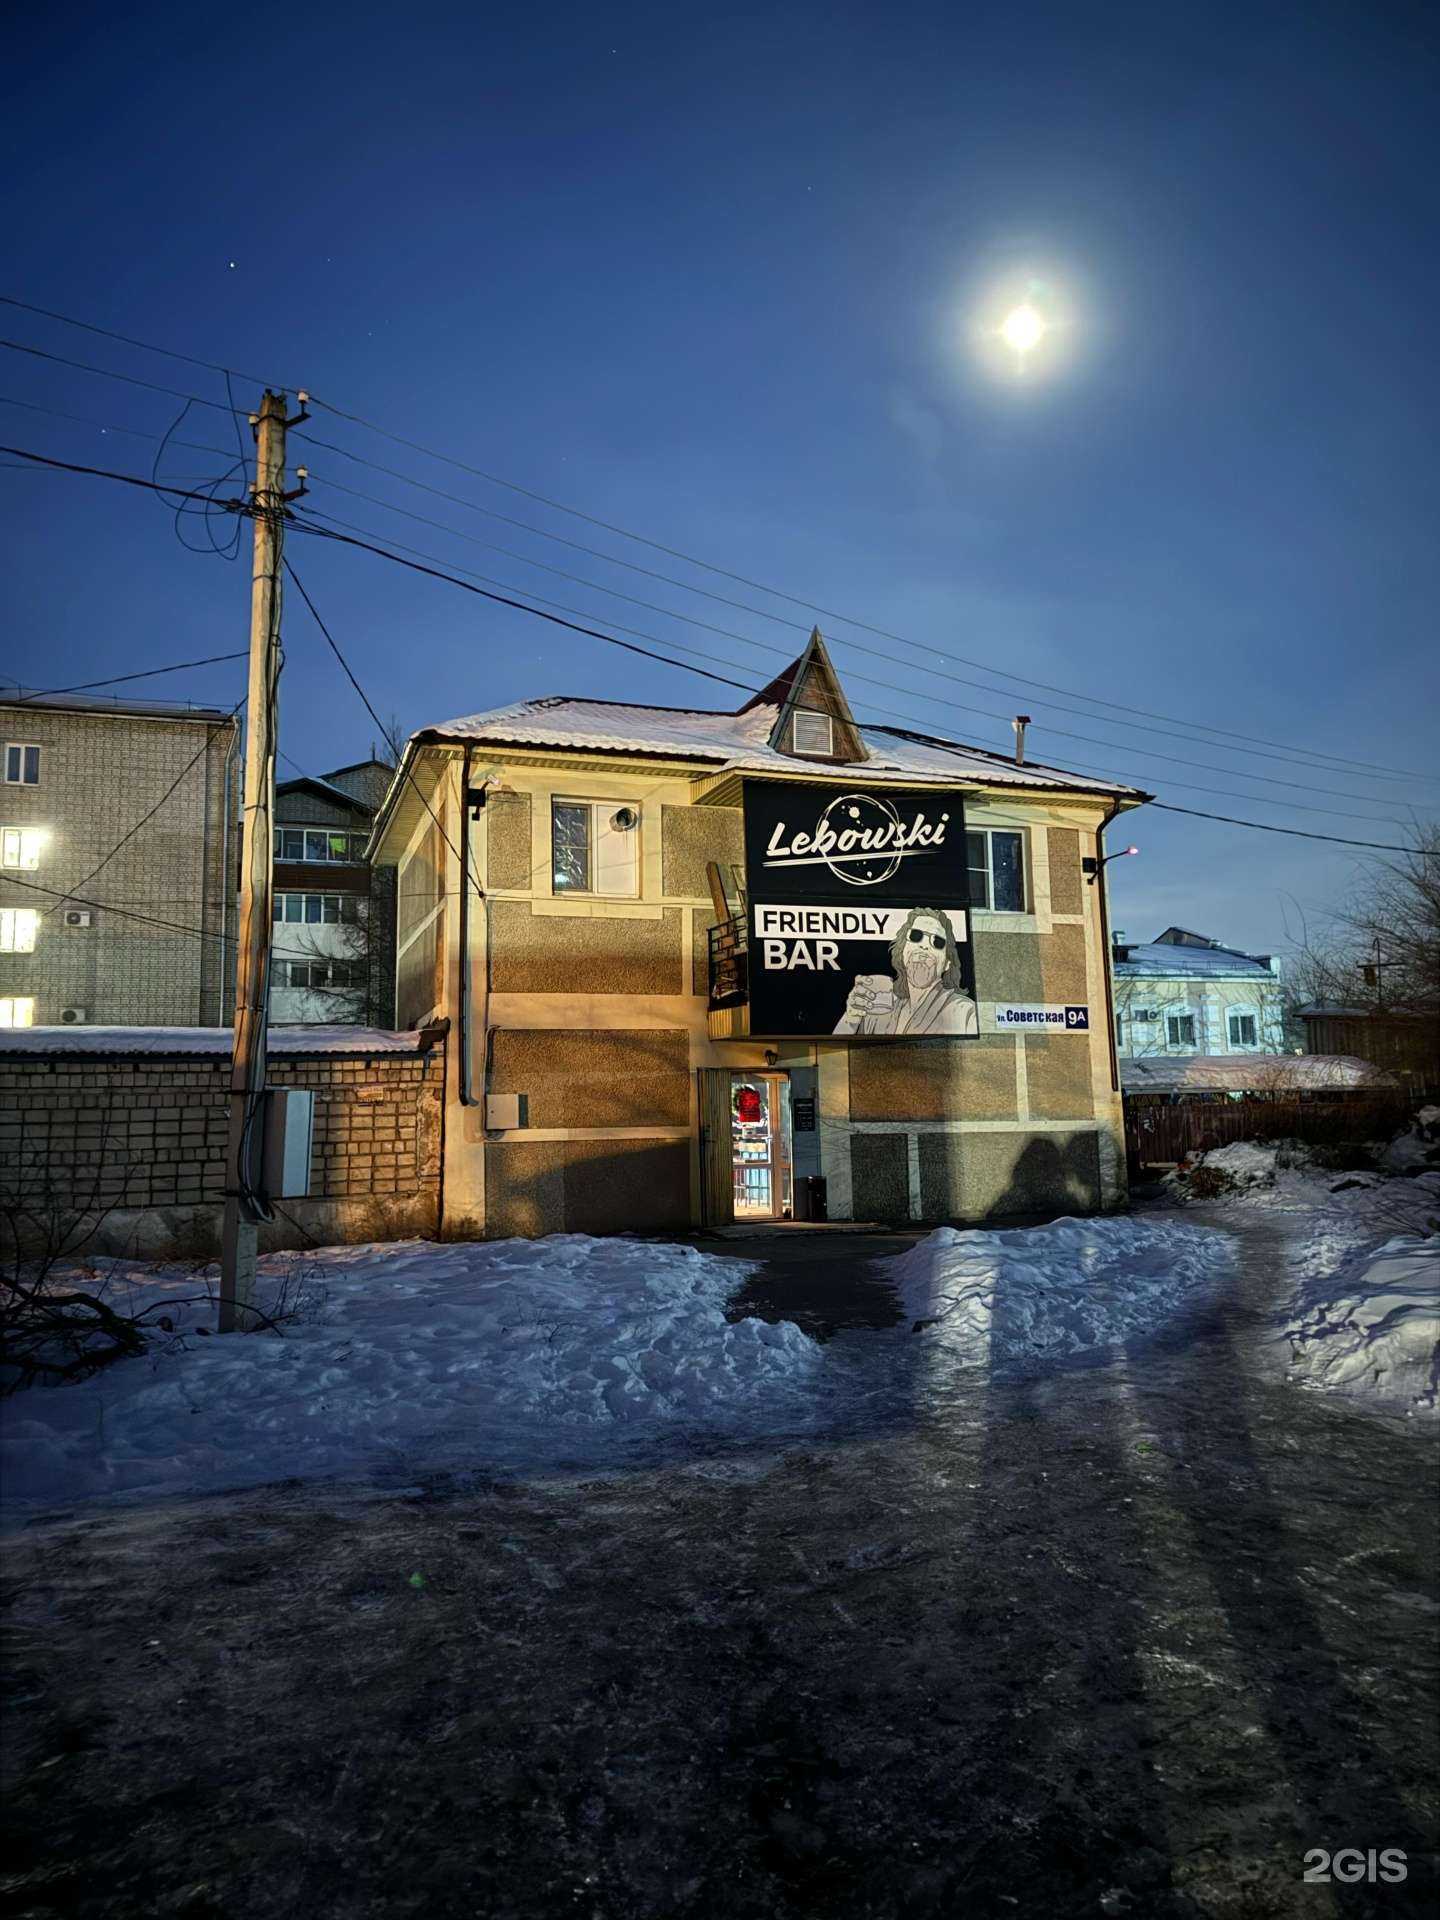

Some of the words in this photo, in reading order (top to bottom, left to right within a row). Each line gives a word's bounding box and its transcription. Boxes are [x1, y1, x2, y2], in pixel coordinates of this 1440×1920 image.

[766, 813, 949, 856] Lebowski
[763, 910, 890, 935] FRIENDLY
[763, 940, 841, 970] BAR
[1006, 1009, 1064, 1023] Советская
